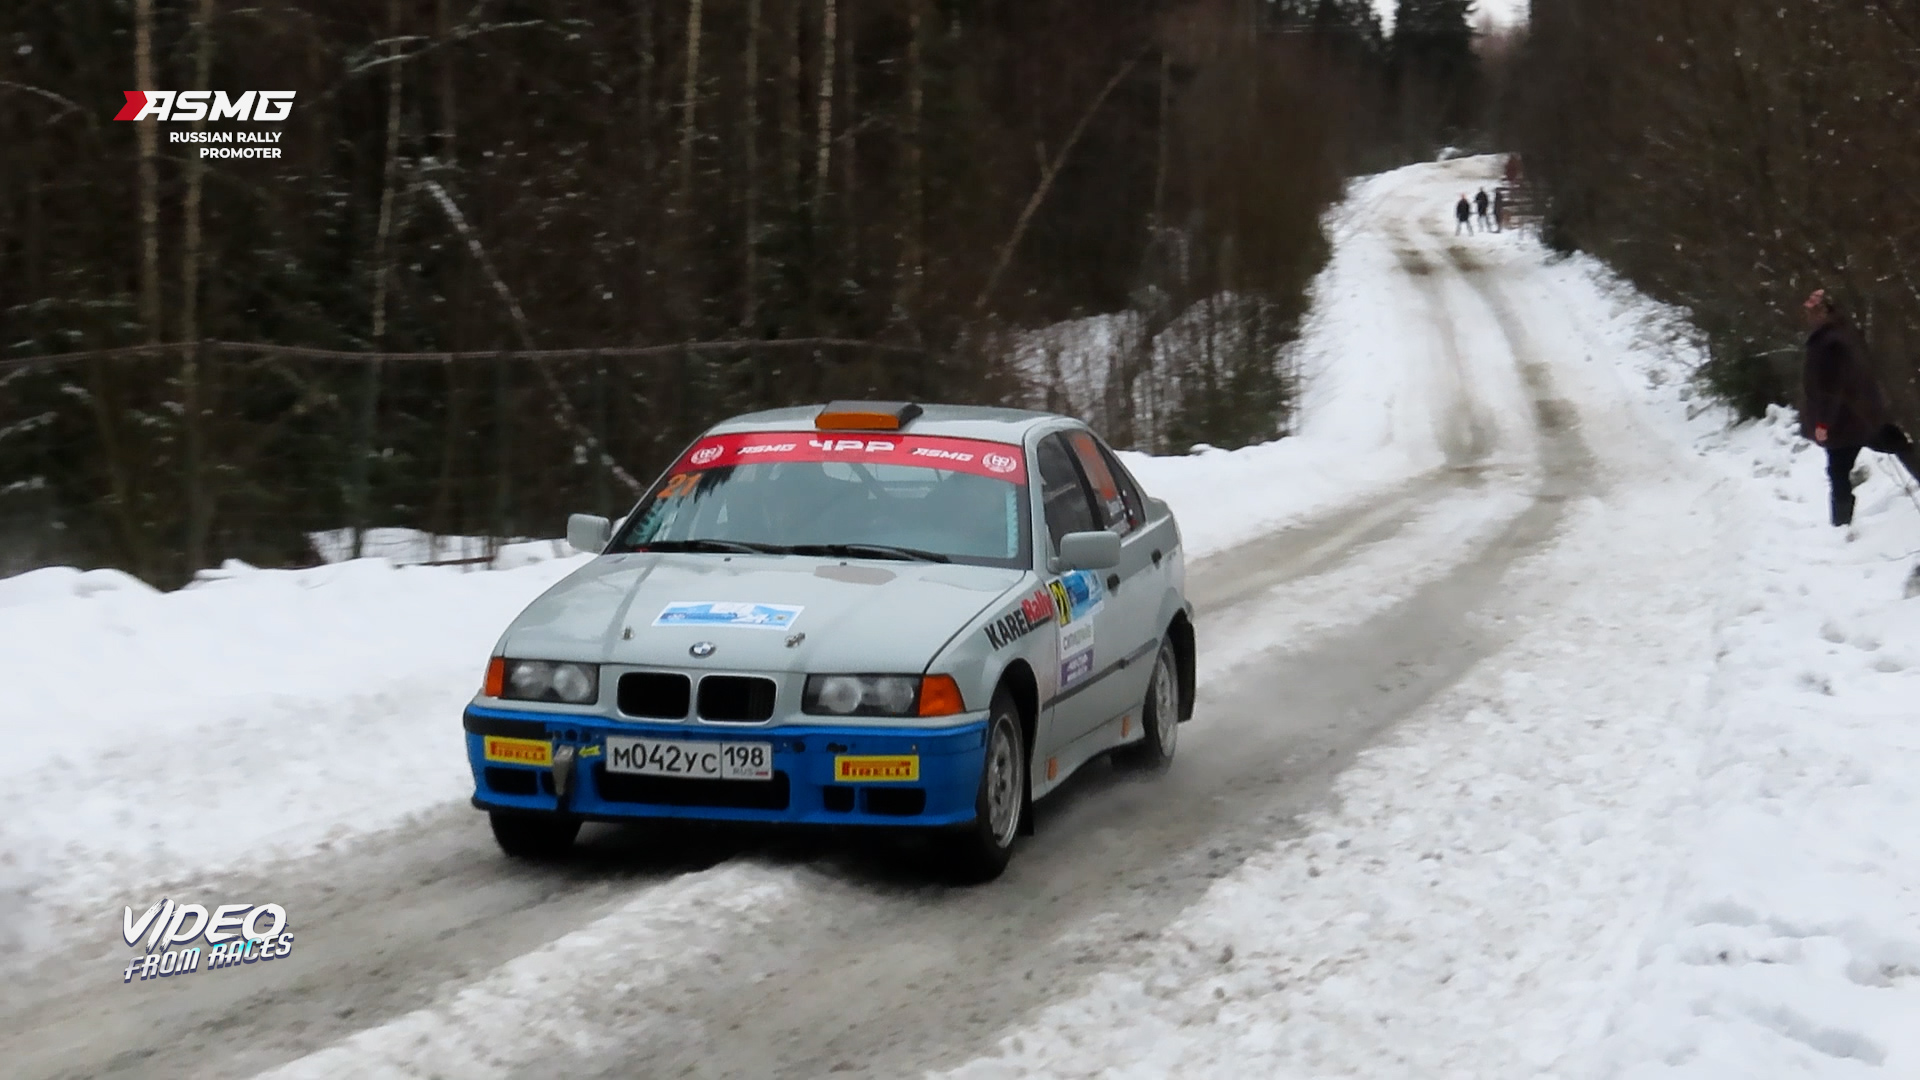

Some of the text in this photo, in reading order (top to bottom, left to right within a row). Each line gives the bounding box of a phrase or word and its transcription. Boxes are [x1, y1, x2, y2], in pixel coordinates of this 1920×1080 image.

[912, 447, 975, 461] ASMG
[656, 473, 704, 499] 21
[723, 746, 765, 768] 198
[842, 760, 912, 776] PIRELLI
